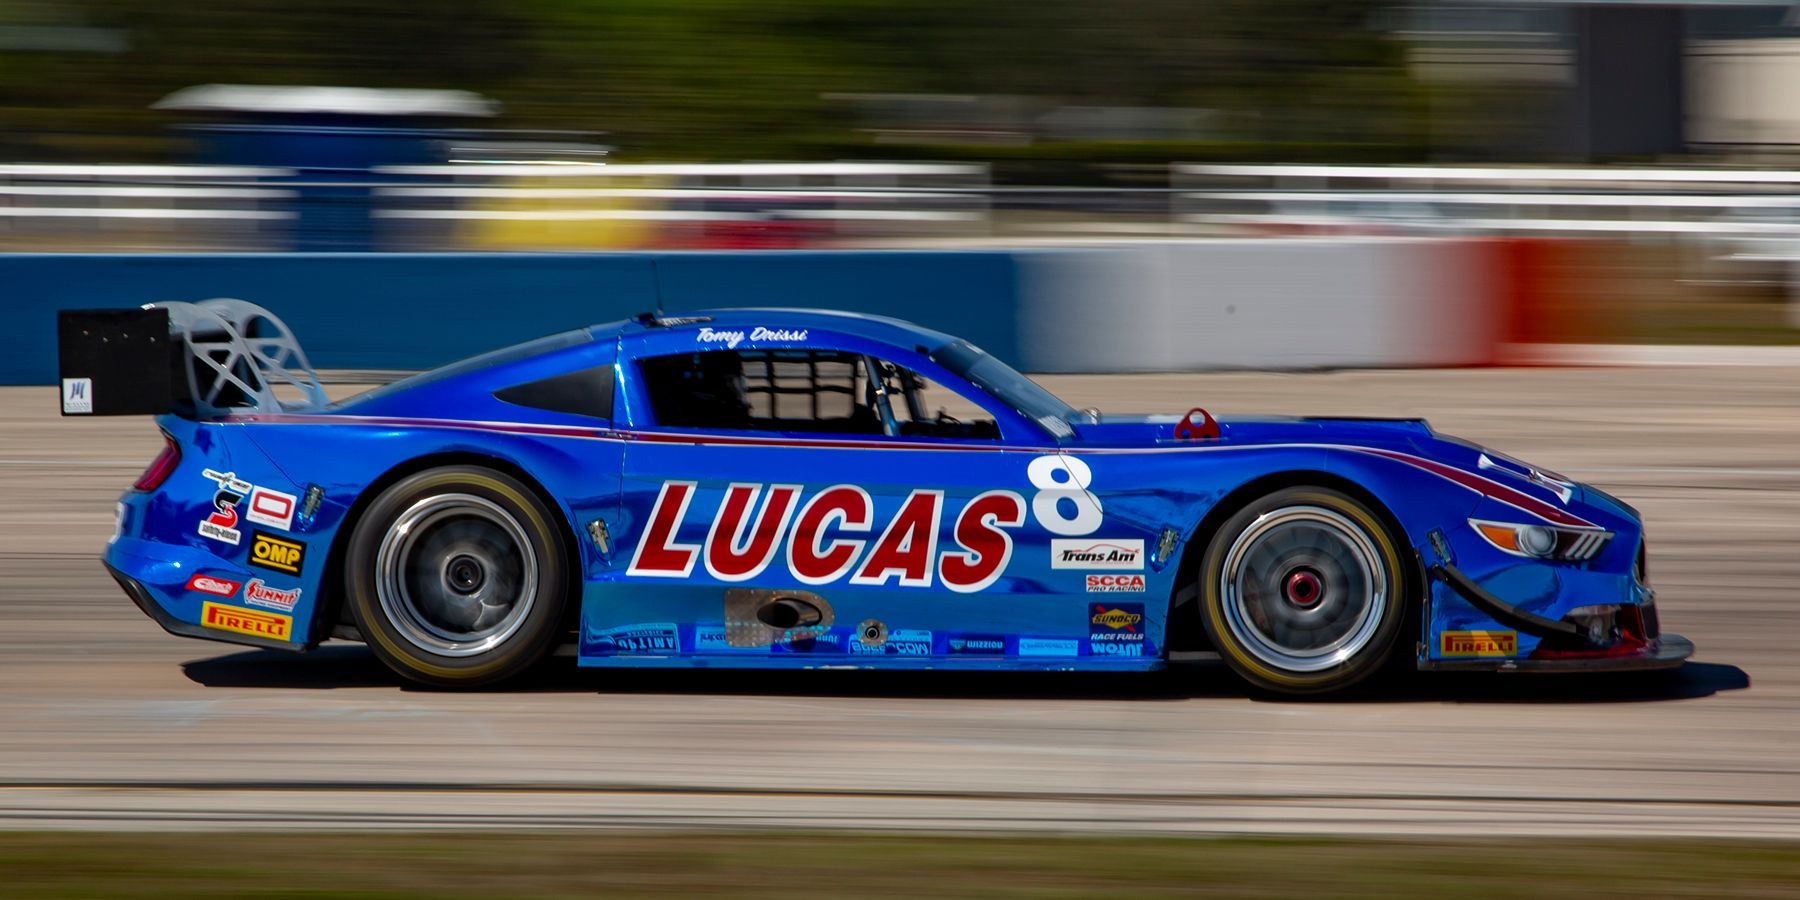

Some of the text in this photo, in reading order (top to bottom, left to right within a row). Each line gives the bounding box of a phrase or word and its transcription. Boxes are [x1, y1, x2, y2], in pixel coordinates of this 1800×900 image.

[696, 326, 808, 349] Tomy Drissi
[1026, 454, 1104, 536] 8
[626, 480, 1027, 594] LUCAS
[254, 541, 300, 565] OMP
[1062, 550, 1136, 562] Trans Am
[1087, 575, 1144, 586] SCCA
[207, 606, 286, 636] PIRELLI
[1092, 614, 1140, 624] SUNOCO
[1445, 635, 1514, 652] PIRELLI
